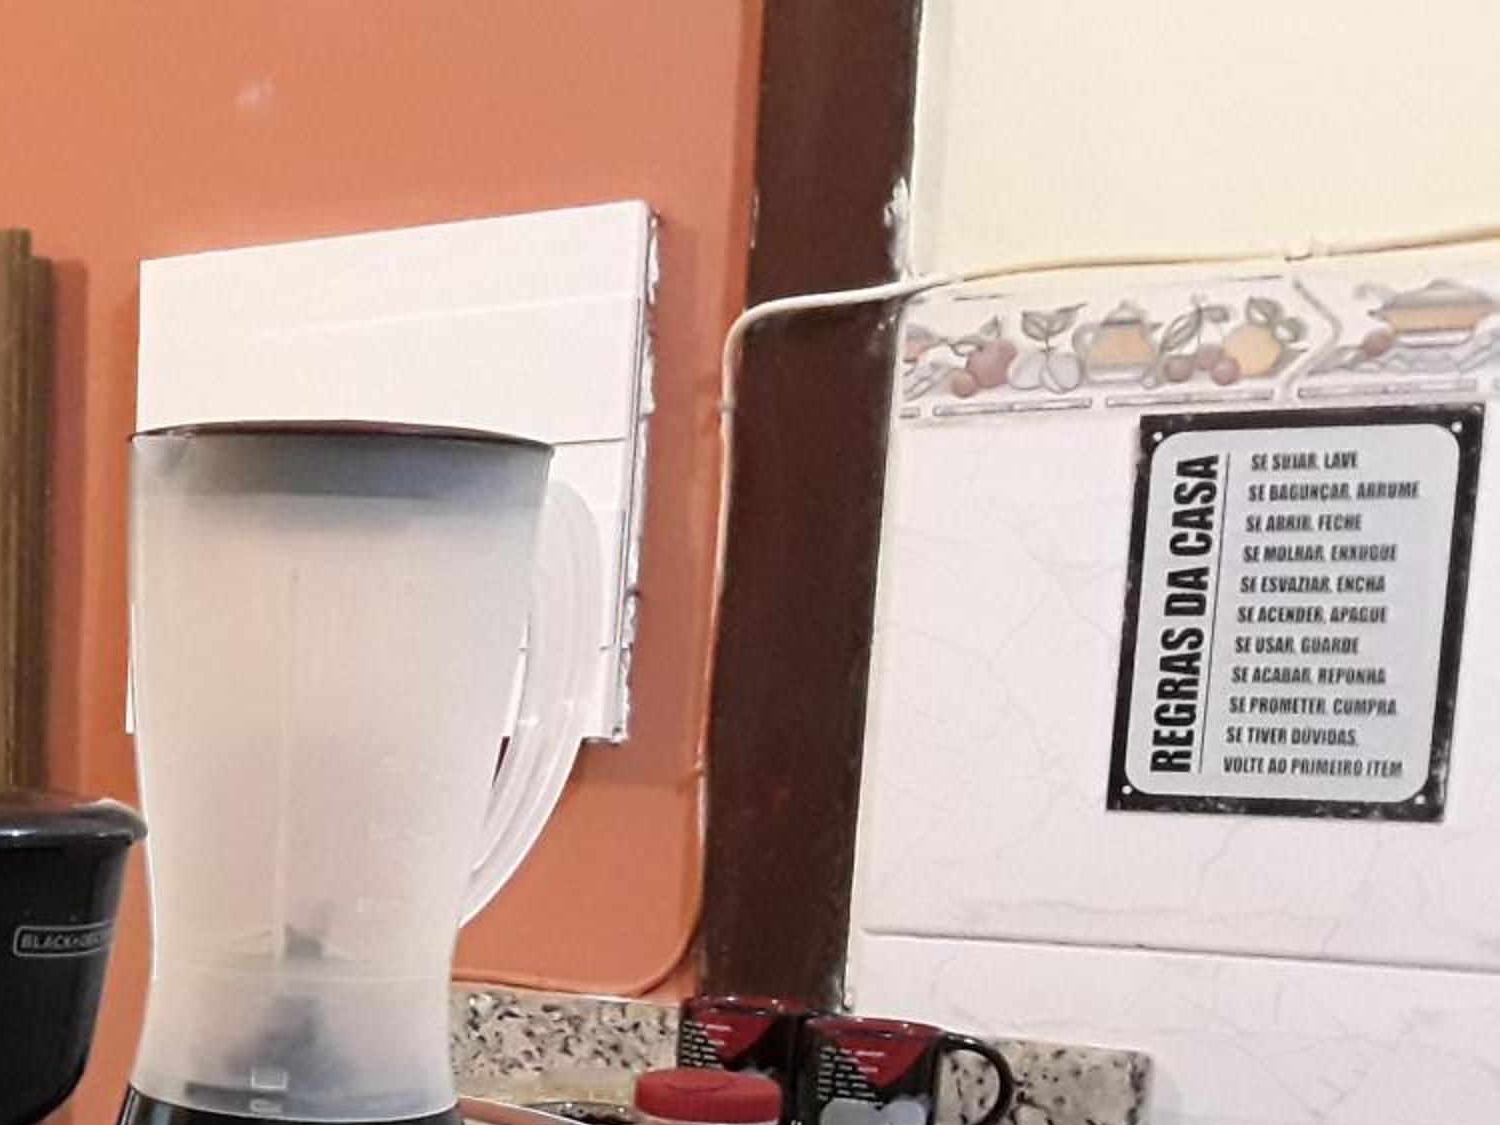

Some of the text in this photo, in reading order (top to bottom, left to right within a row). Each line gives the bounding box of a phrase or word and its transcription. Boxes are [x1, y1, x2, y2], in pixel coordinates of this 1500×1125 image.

[1251, 453, 1268, 471] SE
[1324, 451, 1358, 470] LAVE
[1249, 484, 1266, 502] SE
[1246, 515, 1262, 532] SE
[1317, 513, 1362, 531] FECHE
[1243, 545, 1260, 563] SE
[1240, 575, 1256, 593] SE
[1337, 575, 1386, 593] ENCHA
[1150, 454, 1219, 773] REGRAS DA CASA
[1237, 606, 1254, 624] SE
[1329, 606, 1387, 624] APAGUE
[1235, 636, 1251, 654] SE
[1301, 636, 1359, 655] GUARDE
[1232, 667, 1248, 684] SE
[1229, 696, 1246, 714] SE
[1333, 697, 1397, 716] CUMPRA
[1226, 726, 1243, 743] SE
[1247, 727, 1287, 745] TIVER
[1223, 757, 1403, 777] VOLTE AO PRIMEIRO ITEM
